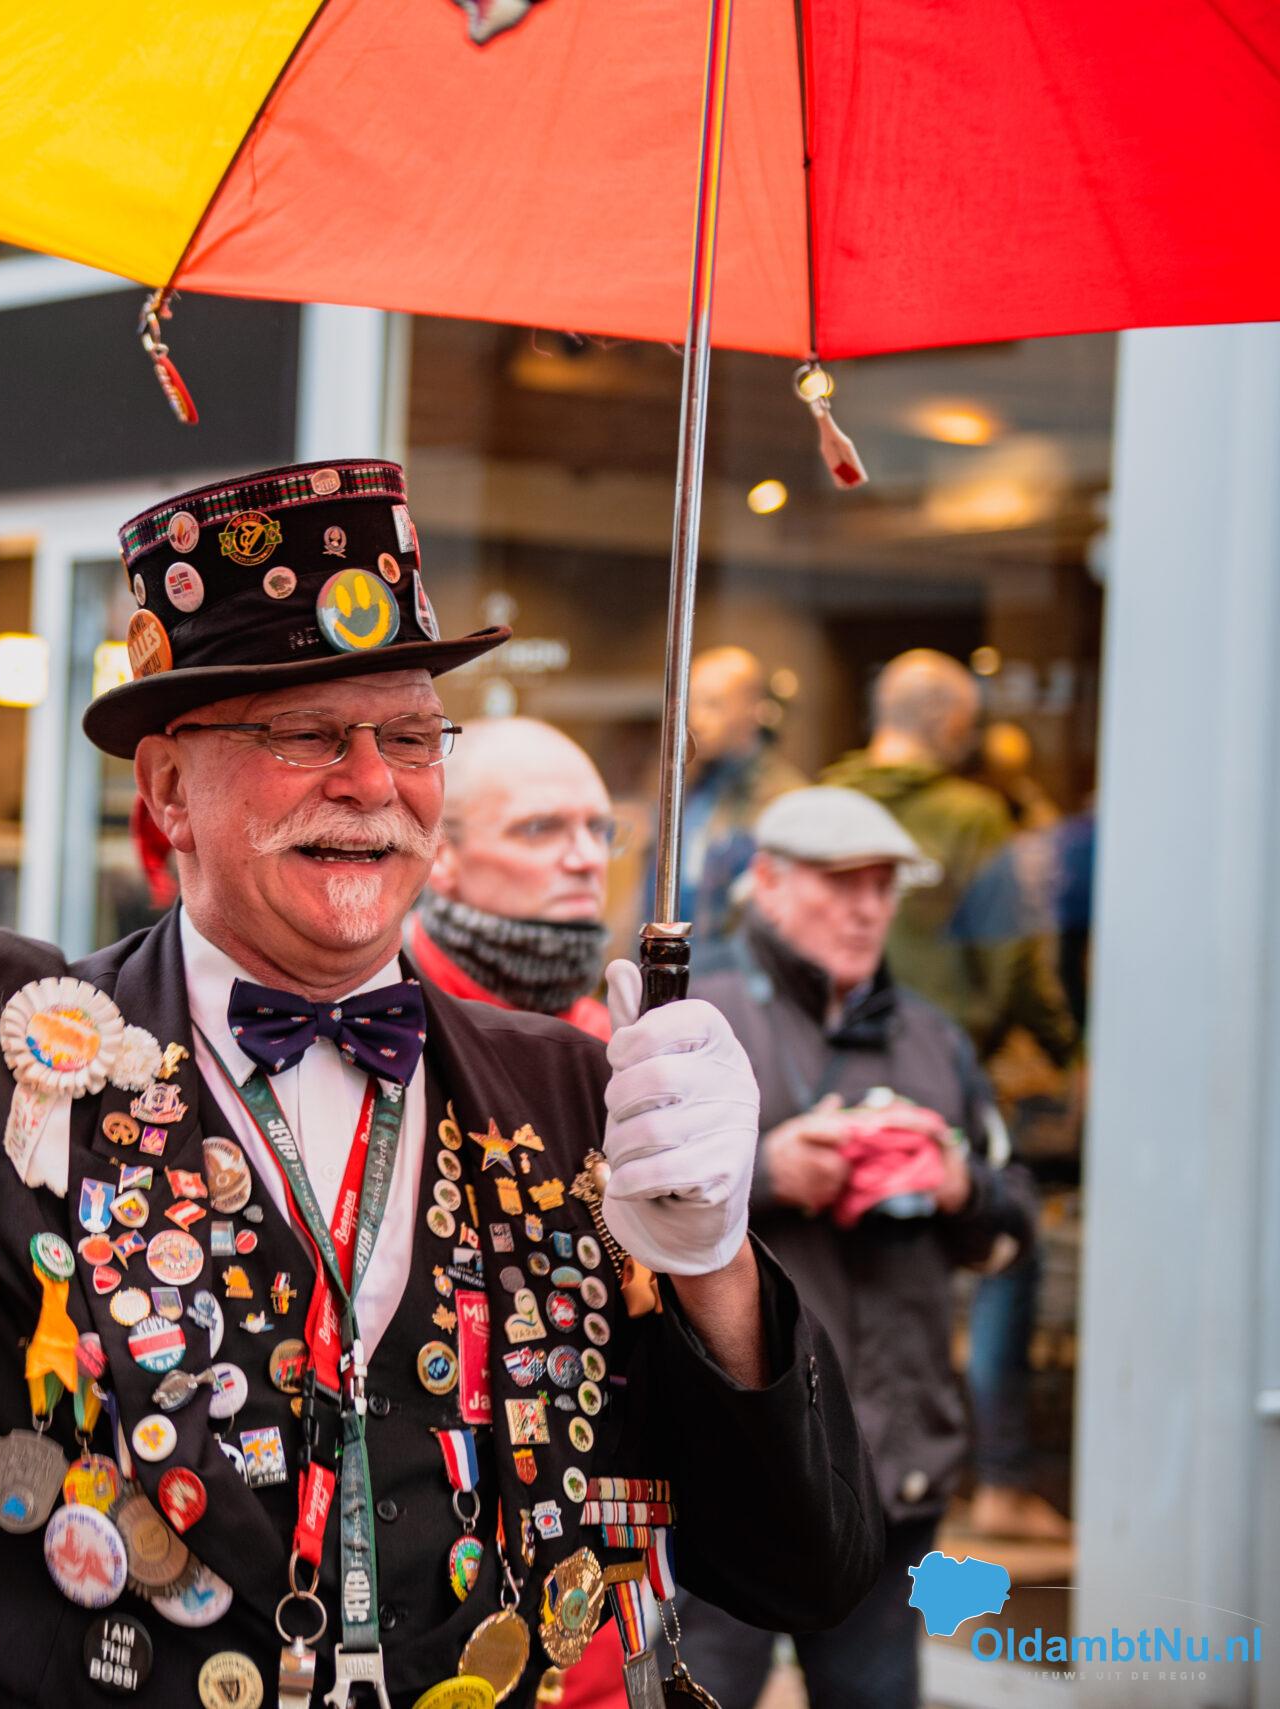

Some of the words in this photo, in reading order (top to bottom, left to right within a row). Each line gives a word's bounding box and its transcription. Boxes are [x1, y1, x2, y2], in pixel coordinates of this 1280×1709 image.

[128, 622, 162, 668] ALLES
[266, 1118, 298, 1160] JEVER
[356, 1228, 373, 1274] JEVER
[468, 1390, 491, 1411] Ja
[257, 1472, 286, 1485] ASSEN
[344, 1569, 371, 1623] JEVER
[104, 1619, 109, 1639] I
[111, 1622, 135, 1648] AM
[101, 1639, 131, 1667] THE
